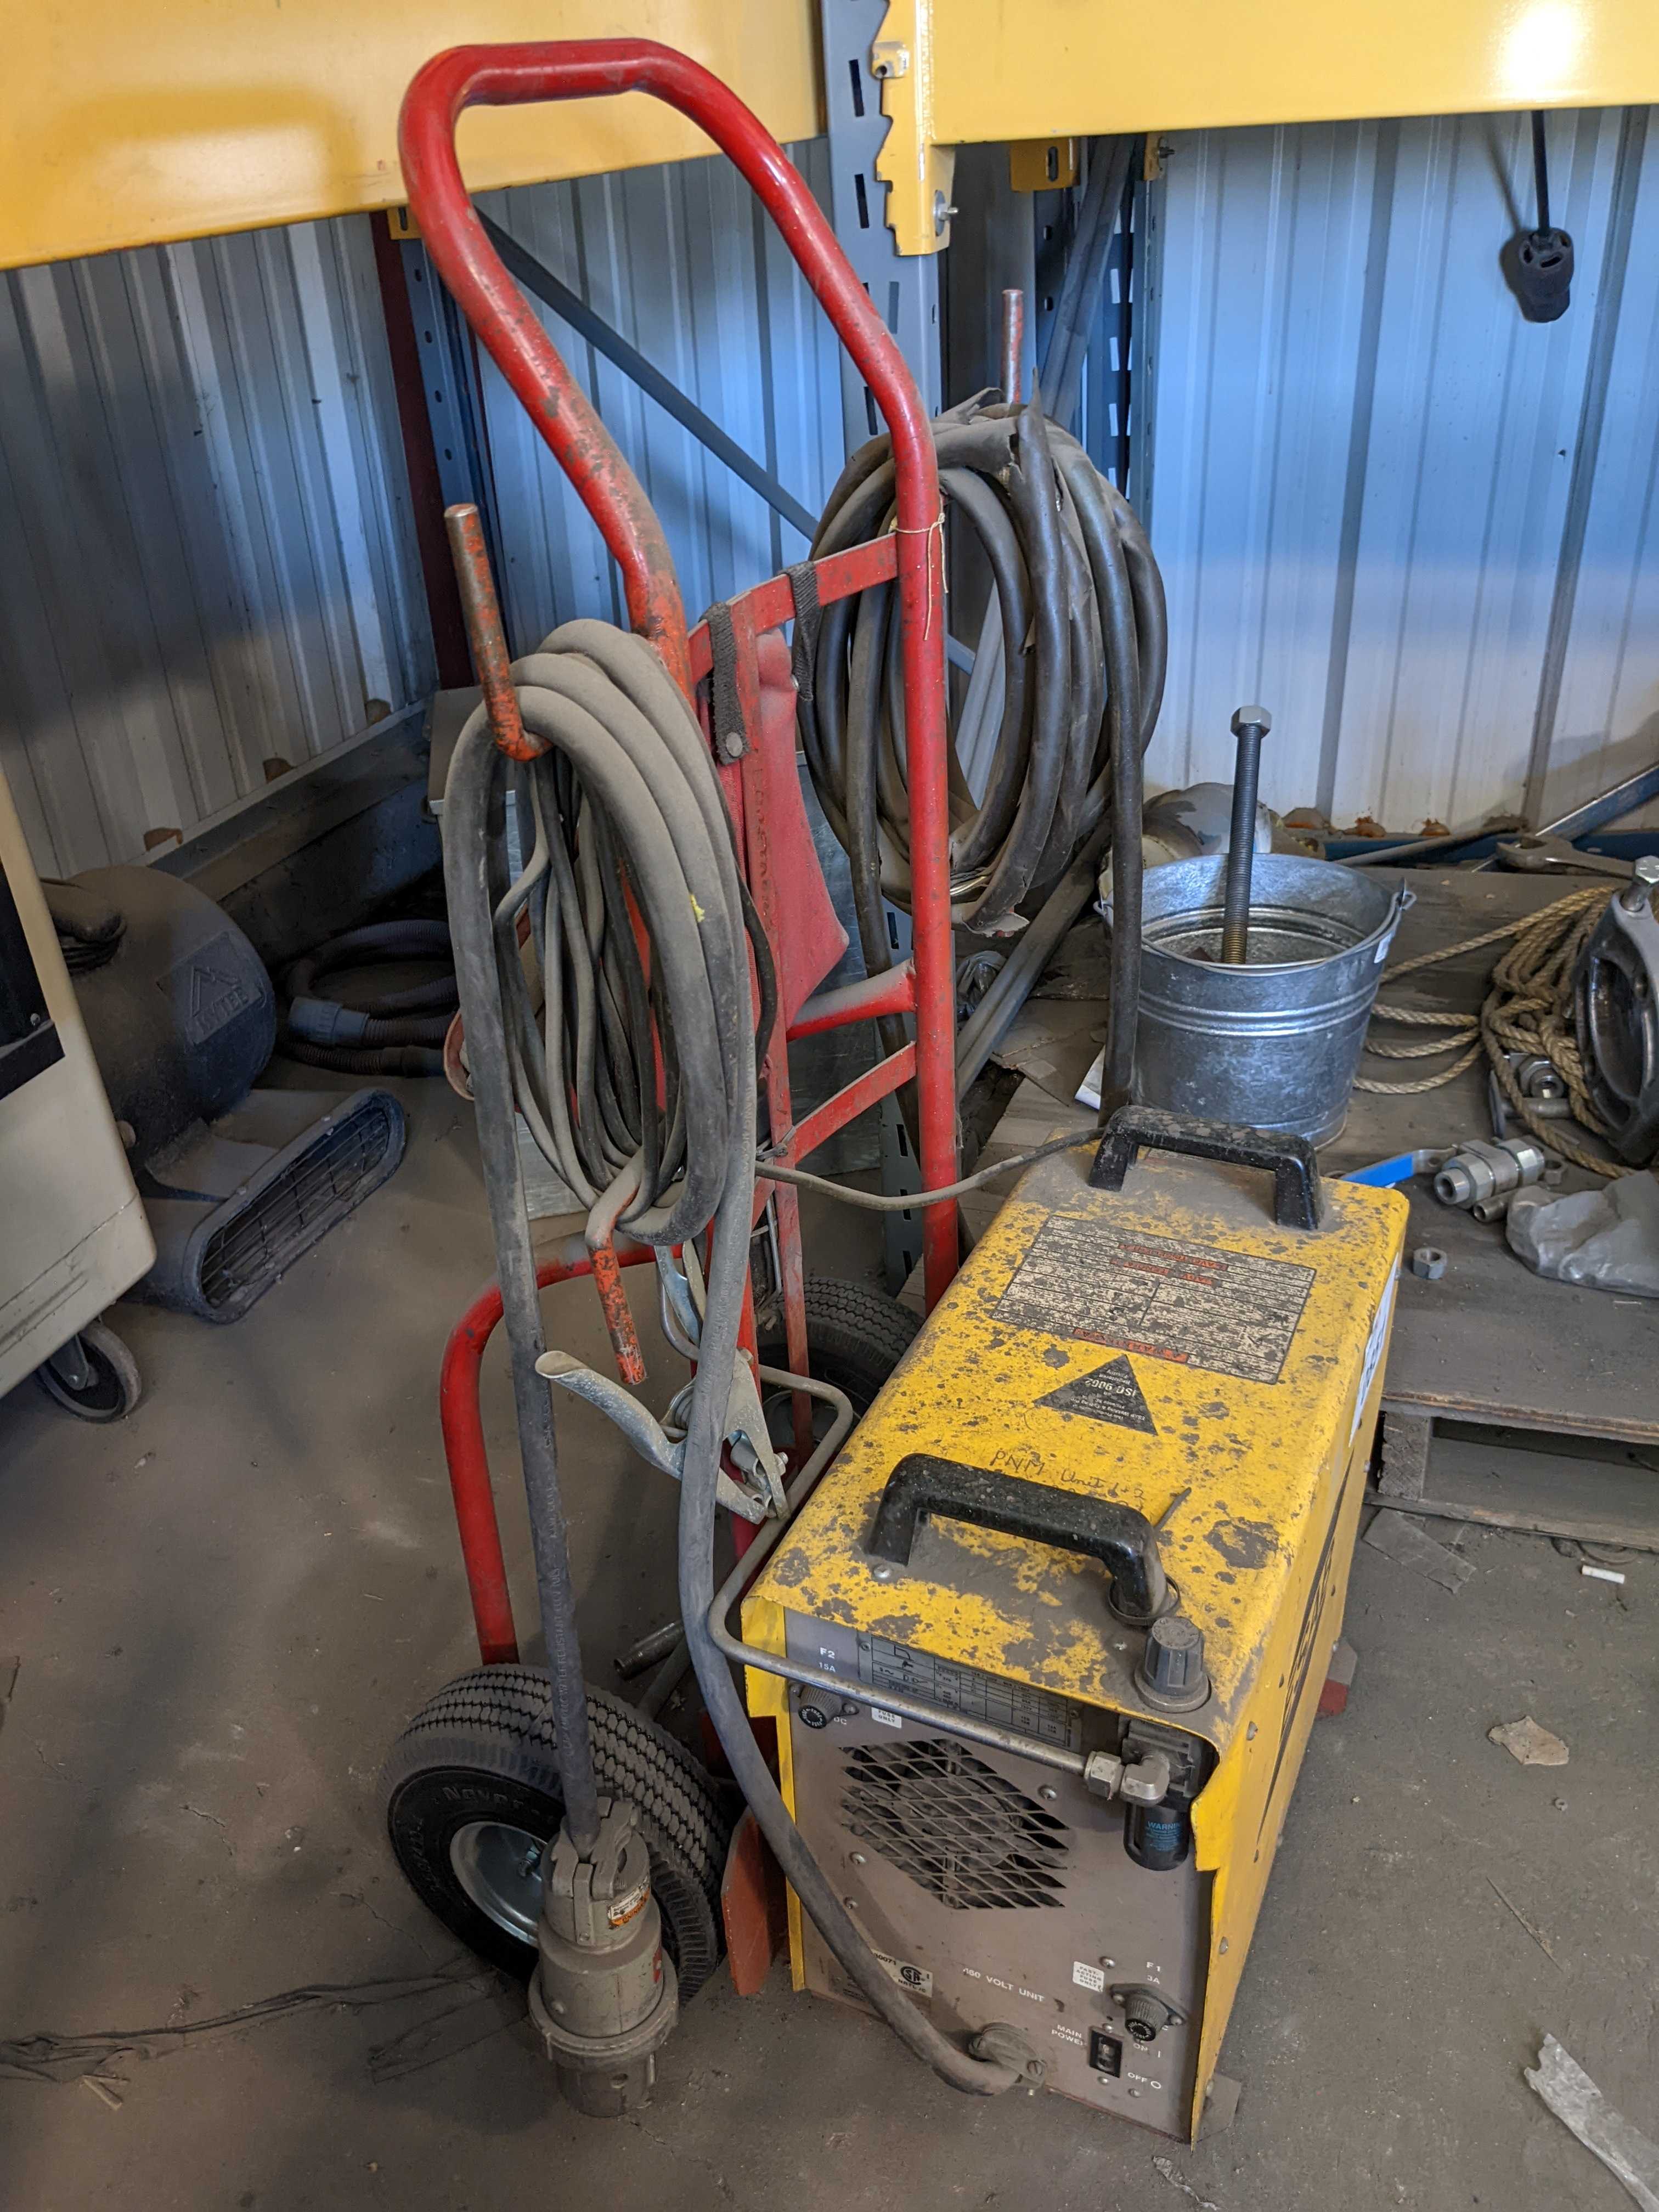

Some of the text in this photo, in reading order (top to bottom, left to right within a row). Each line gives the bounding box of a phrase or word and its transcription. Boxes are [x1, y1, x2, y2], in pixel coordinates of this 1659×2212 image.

[1085, 1378, 1136, 1397] ISO 9002
[820, 1647, 836, 1659] F2
[819, 1662, 836, 1672] 15A
[878, 1714, 895, 1723] ONLY
[1146, 1962, 1161, 1972] F1
[1076, 1970, 1102, 1981] ACTING
[1080, 1975, 1097, 1983] FUSE
[1147, 1975, 1160, 1984] 3A
[986, 1975, 1014, 1990] VOLT
[1019, 1988, 1045, 2002] UNIT
[1057, 2025, 1082, 2038] MAIN
[1133, 2042, 1148, 2052] ON
[1128, 2072, 1148, 2083] OFF
